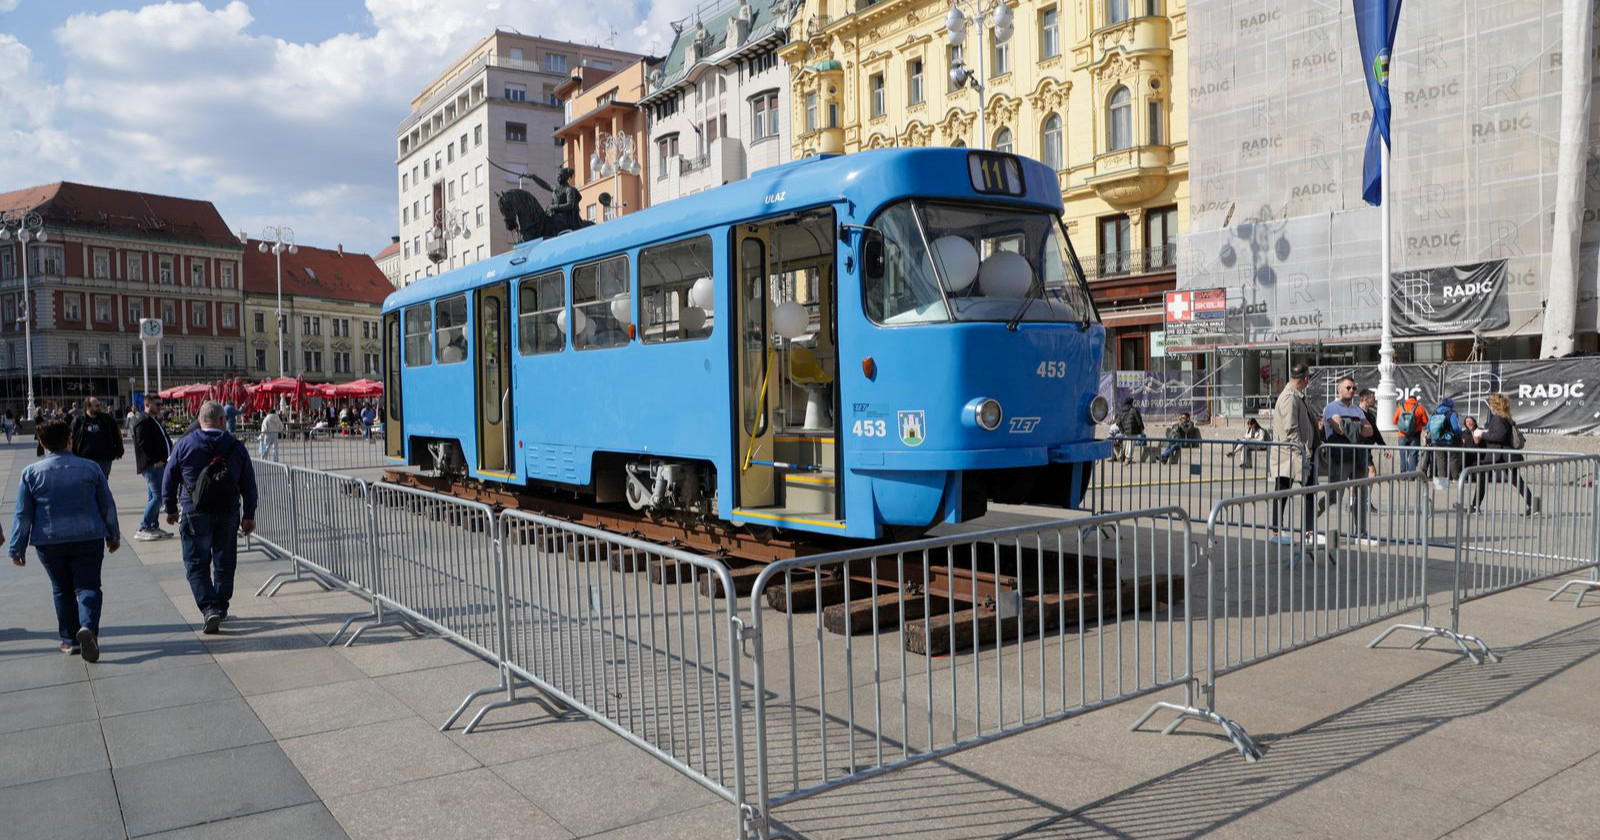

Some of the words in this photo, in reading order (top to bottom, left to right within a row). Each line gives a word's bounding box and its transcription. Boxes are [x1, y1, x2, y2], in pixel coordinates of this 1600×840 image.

[1240, 6, 1281, 30] RADIĆ
[1291, 48, 1337, 71] RADIĆ
[1190, 78, 1230, 99] RADIĆ
[1404, 78, 1459, 105] RADIĆ
[1471, 113, 1533, 138] RADIĆ
[1241, 134, 1283, 153] RADIĆ
[981, 160, 1004, 190] 11
[764, 191, 786, 205] ULAZ
[1291, 180, 1337, 199] RADIĆ
[1407, 230, 1461, 249] RADIĆ
[1036, 361, 1066, 378] 453
[1518, 379, 1585, 398] RADIĆ
[852, 419, 887, 437] 453
[1009, 417, 1042, 433] ZET
